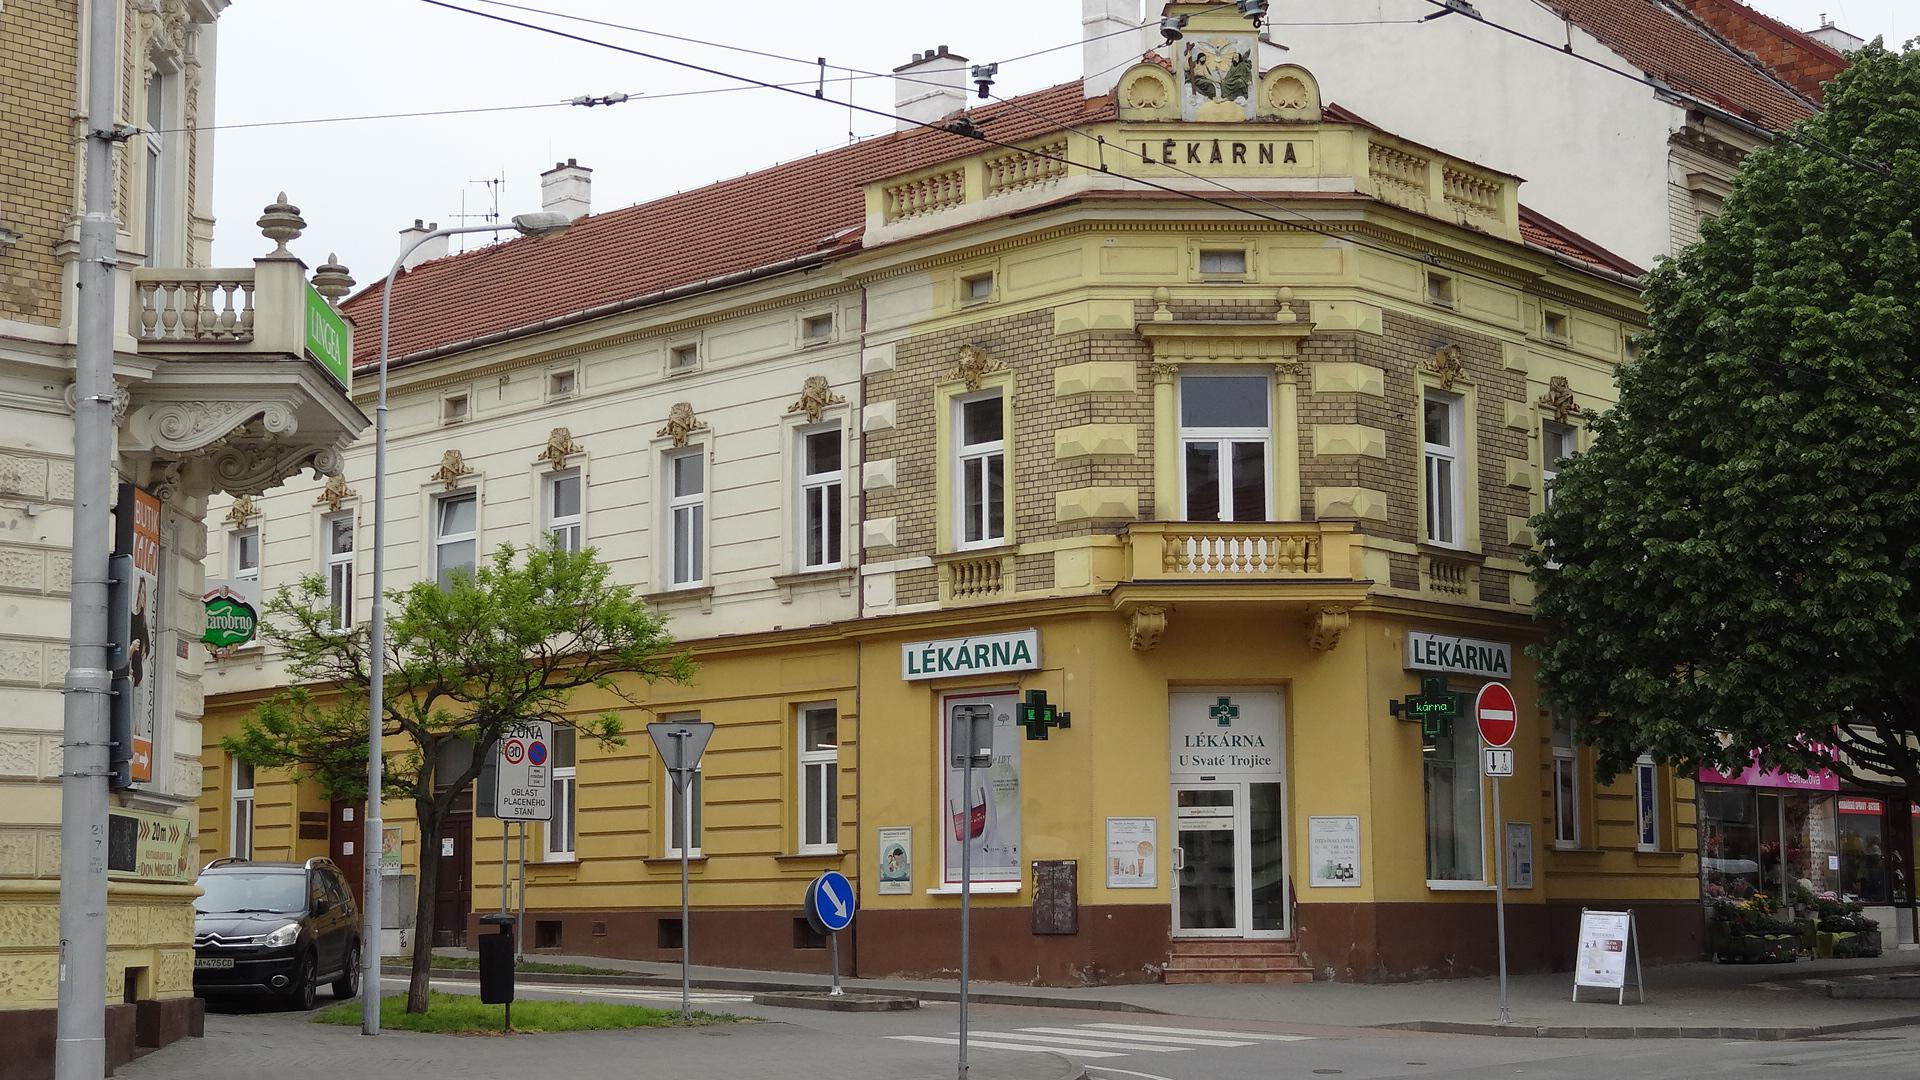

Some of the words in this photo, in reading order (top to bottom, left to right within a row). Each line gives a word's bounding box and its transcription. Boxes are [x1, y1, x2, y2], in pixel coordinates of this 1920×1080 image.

[1142, 138, 1297, 164] LÉKÁRNA
[311, 306, 341, 365] LINGEA
[135, 500, 160, 535] BUTIK
[206, 607, 252, 633] tarobrno
[908, 639, 1032, 675] LÉKÁRNA
[1414, 635, 1508, 673] LÉKÁRNA
[1416, 701, 1447, 712] kárna
[1184, 731, 1265, 748] LÉKÁRNA
[508, 746, 520, 758] 30
[1179, 755, 1189, 766] U
[1192, 754, 1225, 766] Svaté
[1229, 754, 1272, 768] Trojice
[511, 788, 538, 797] OBLAST
[503, 797, 546, 807] PLACENÉHO
[514, 806, 535, 816] STÁNÍ
